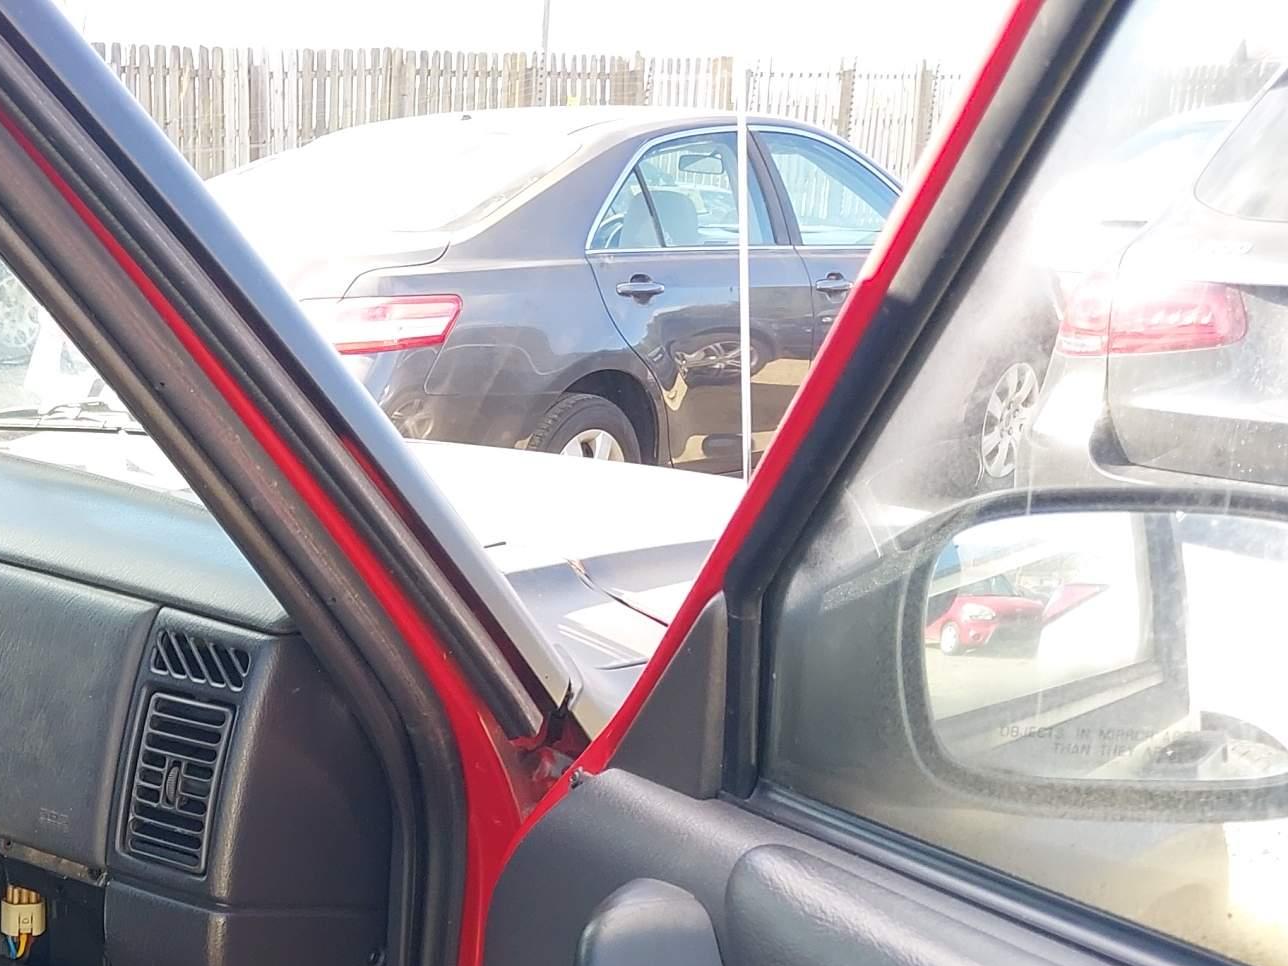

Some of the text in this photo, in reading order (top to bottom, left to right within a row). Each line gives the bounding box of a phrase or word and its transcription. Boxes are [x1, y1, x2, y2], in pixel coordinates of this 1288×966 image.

[999, 726, 1064, 739] OBJECTS
[1076, 727, 1090, 738] IN
[1053, 742, 1091, 754] THAN
